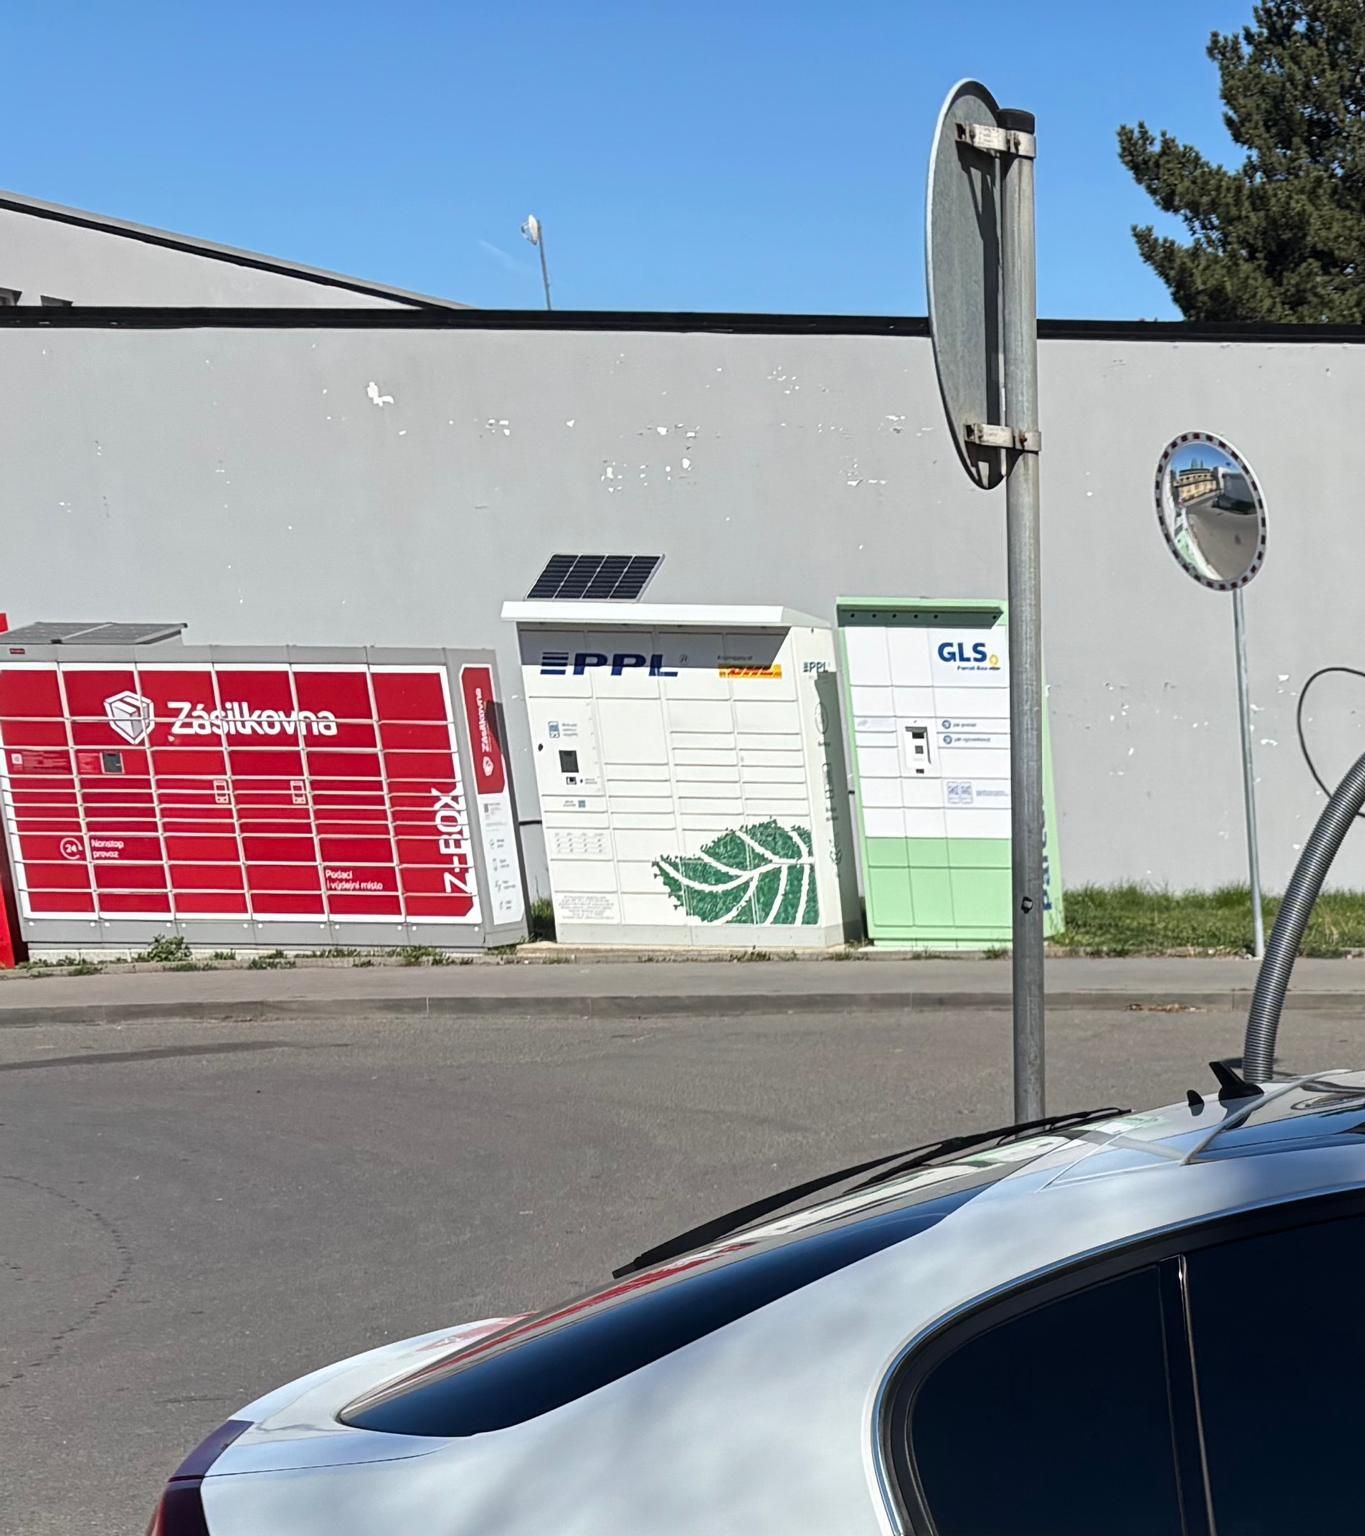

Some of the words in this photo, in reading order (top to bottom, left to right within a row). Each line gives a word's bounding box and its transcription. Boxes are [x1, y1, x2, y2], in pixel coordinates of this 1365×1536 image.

[937, 642, 988, 663] GLS
[573, 653, 679, 677] PPL
[167, 701, 338, 737] Zásilkovna
[65, 844, 77, 853] 24
[91, 839, 124, 849] Nonstop
[431, 787, 473, 894] Z-BOX
[93, 850, 119, 858] provoz
